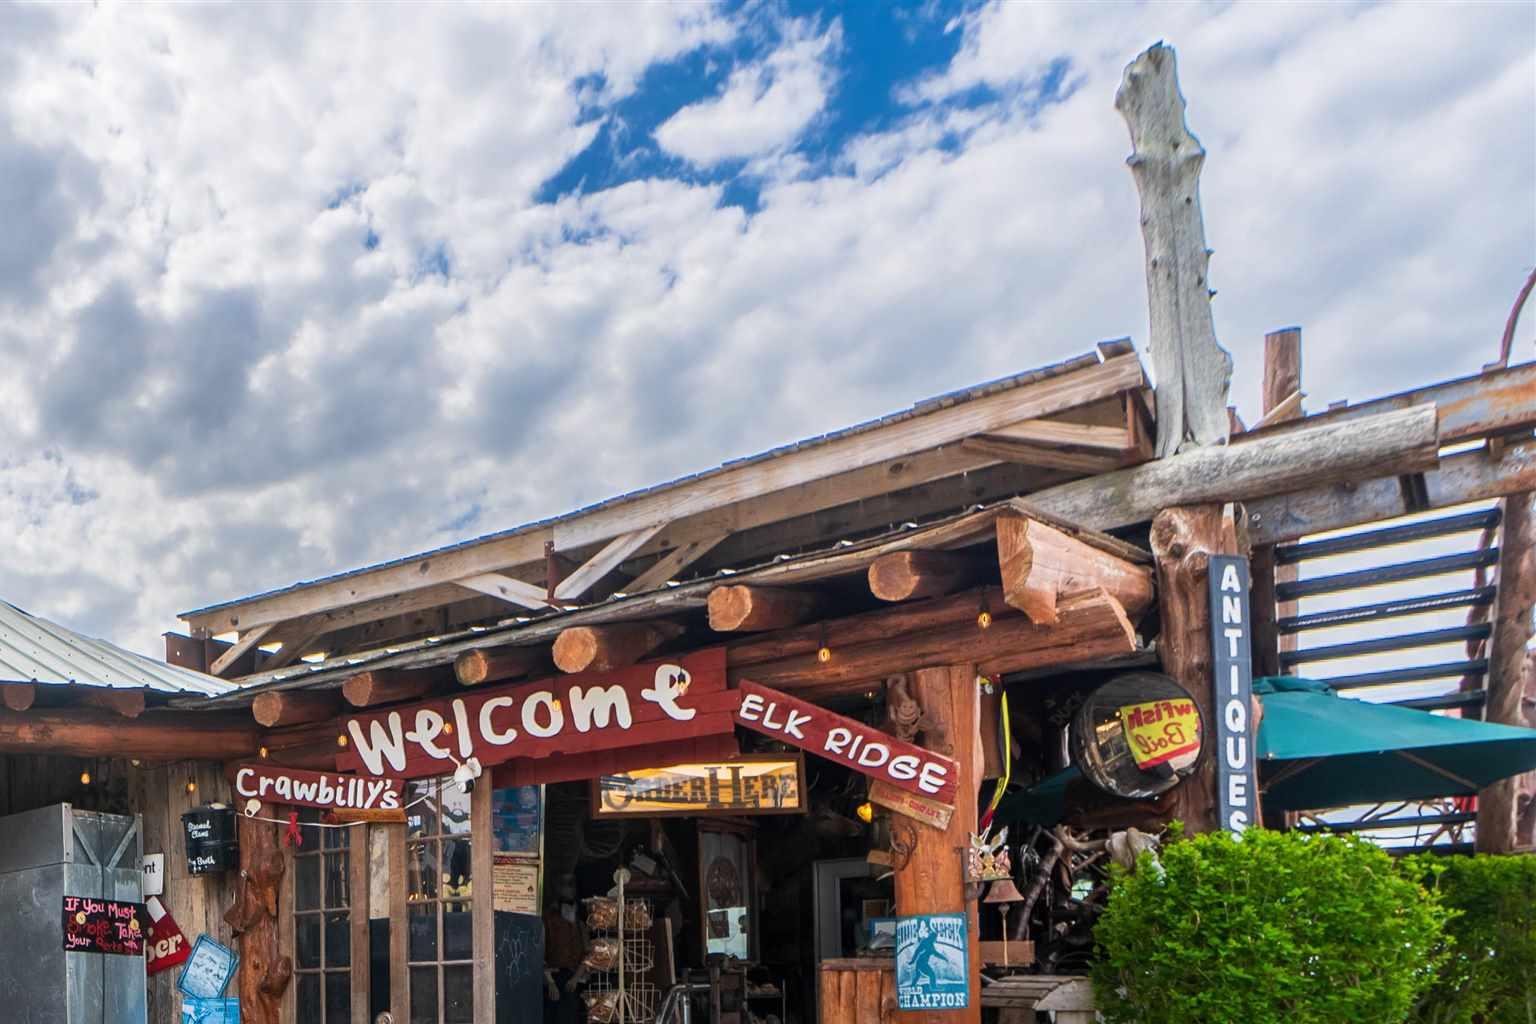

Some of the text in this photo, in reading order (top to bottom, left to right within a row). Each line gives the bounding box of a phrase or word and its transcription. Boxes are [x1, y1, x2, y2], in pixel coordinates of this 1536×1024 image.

[347, 664, 696, 775] Welcome
[1221, 565, 1249, 843] ANTIQUES
[739, 694, 947, 793] ELK RIDGE
[236, 767, 400, 810] Crawbilly's
[83, 899, 104, 915] You
[108, 903, 136, 919] Must
[899, 993, 966, 1009] CHAMPION
